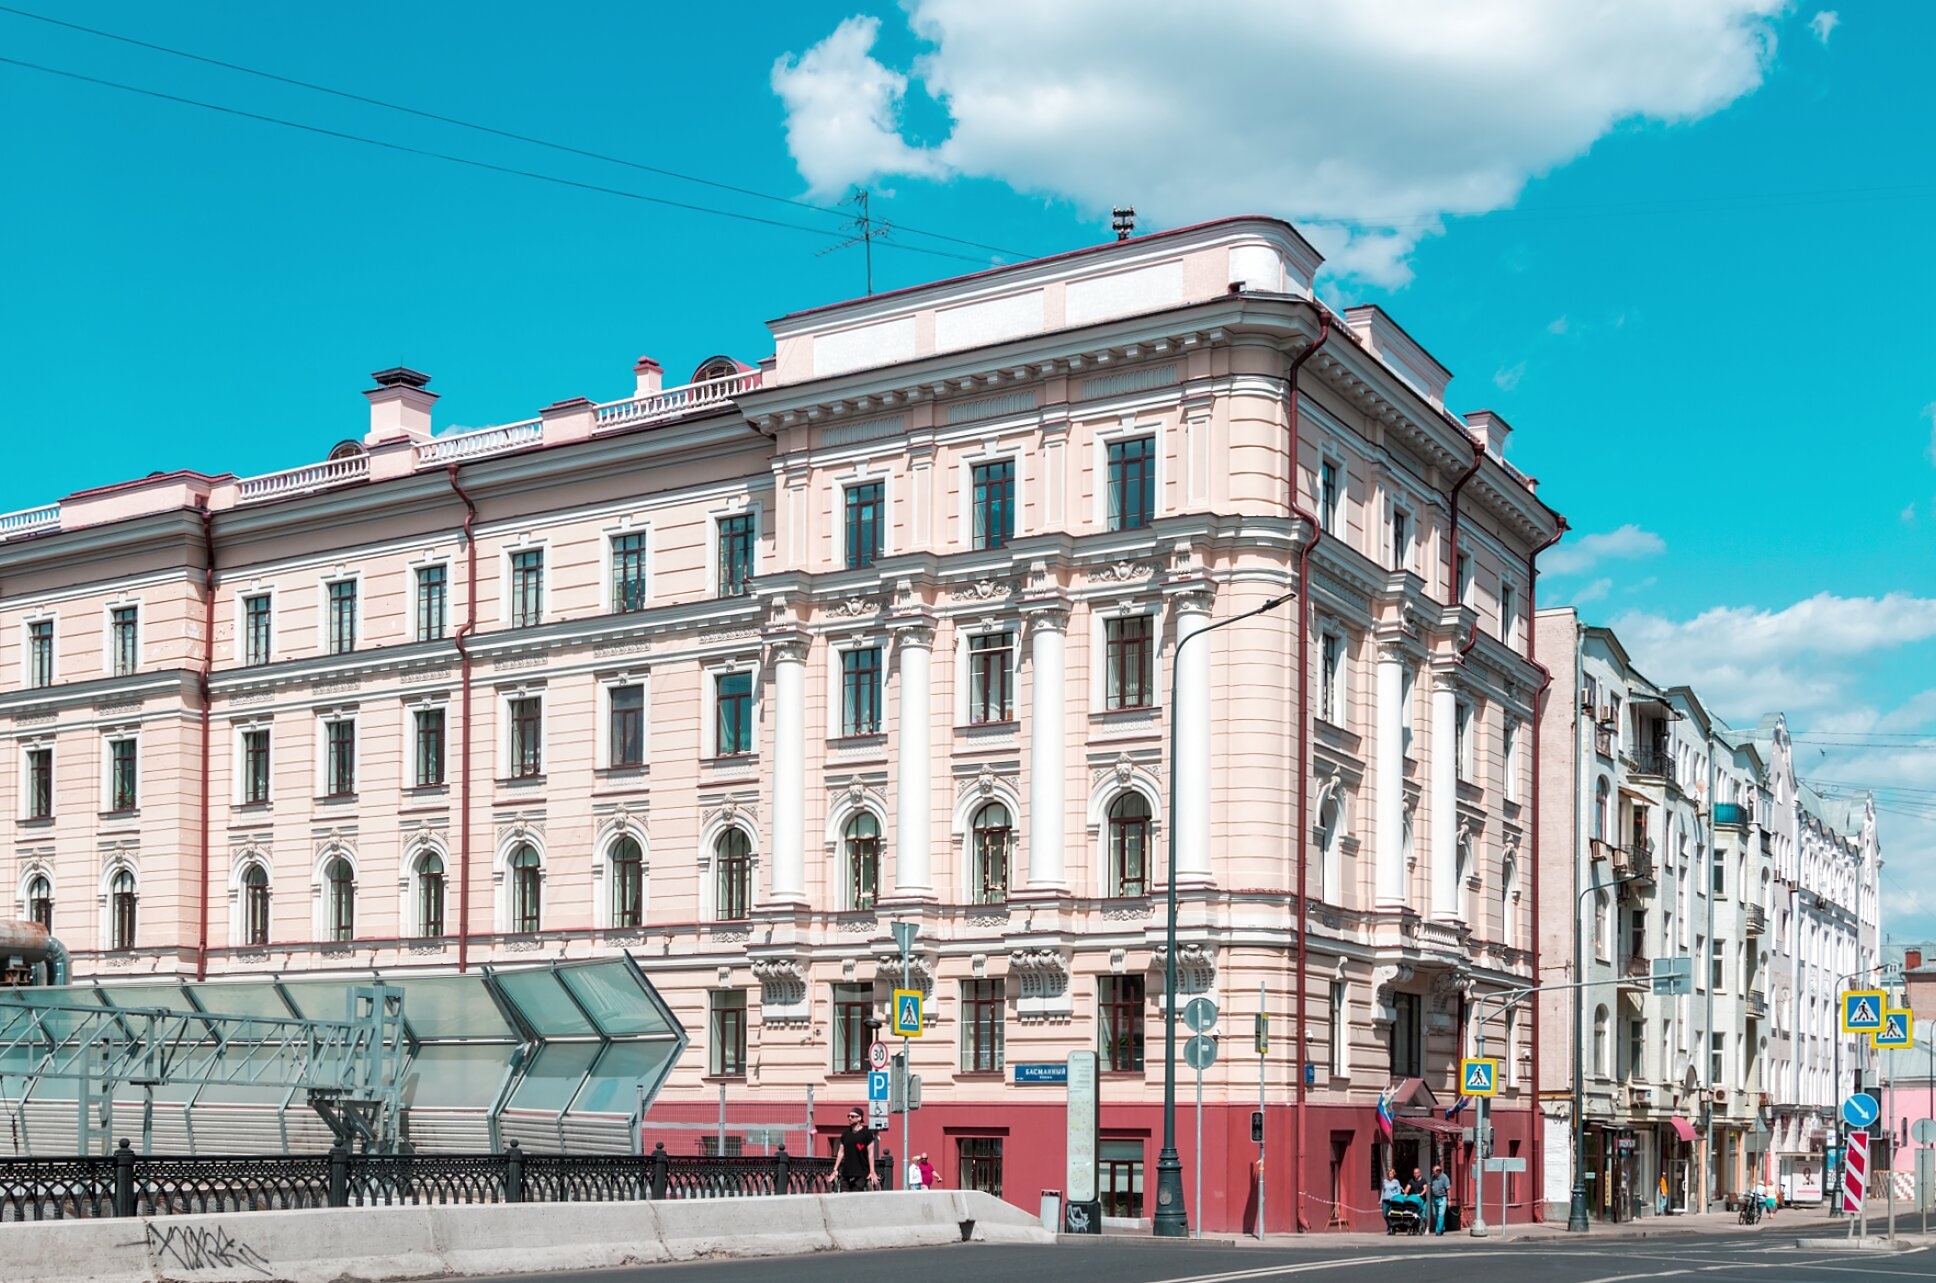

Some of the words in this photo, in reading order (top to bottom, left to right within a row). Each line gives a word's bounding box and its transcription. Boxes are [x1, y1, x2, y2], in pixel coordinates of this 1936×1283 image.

[873, 1049, 885, 1061] 30
[1025, 1067, 1066, 1076] БАСМАННЫЙ
[873, 1074, 885, 1098] P
